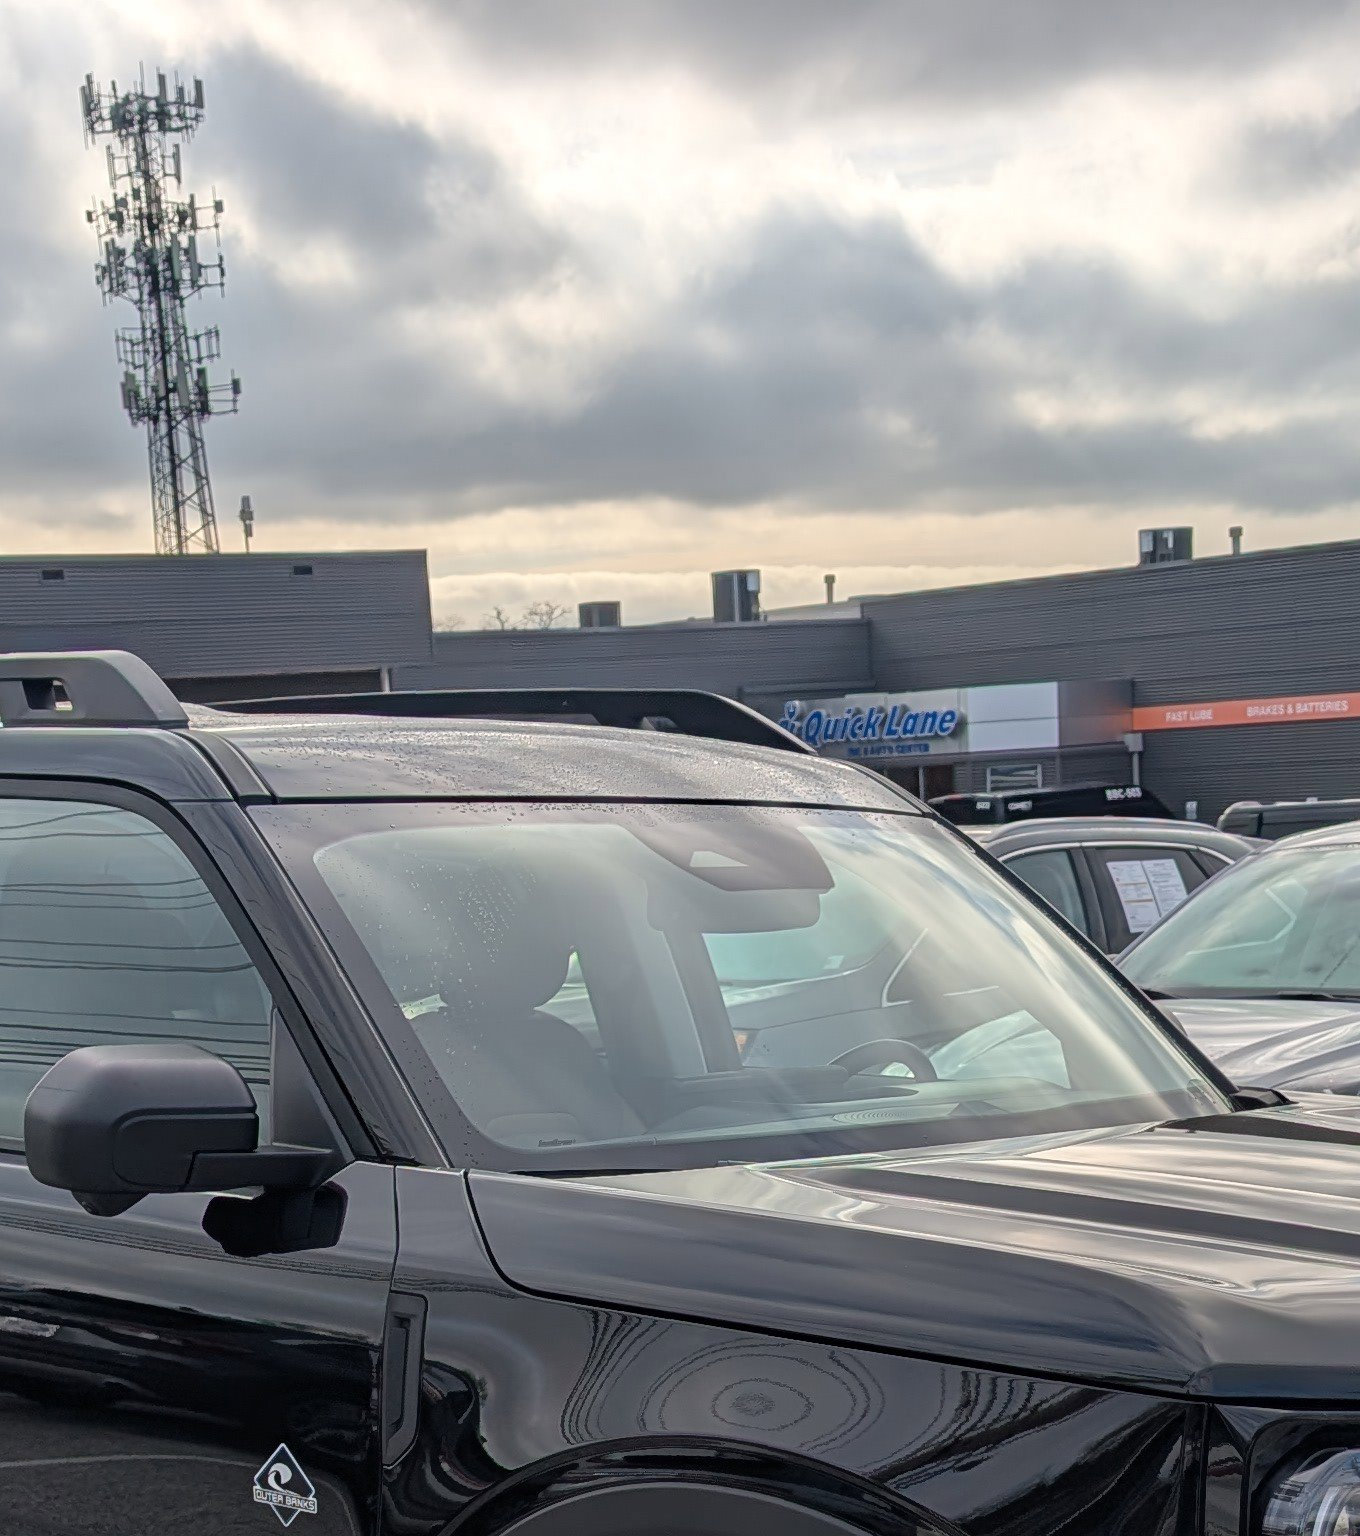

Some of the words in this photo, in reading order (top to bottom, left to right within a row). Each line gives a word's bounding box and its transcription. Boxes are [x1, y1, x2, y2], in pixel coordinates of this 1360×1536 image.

[1165, 710, 1188, 723] FAST
[1246, 704, 1285, 718] BRAKES
[1295, 700, 1350, 714] BATTERIES
[802, 706, 884, 747] Quick
[882, 704, 958, 738] Lane
[256, 1490, 284, 1503] OUTER
[285, 1497, 315, 1510] BANKS
